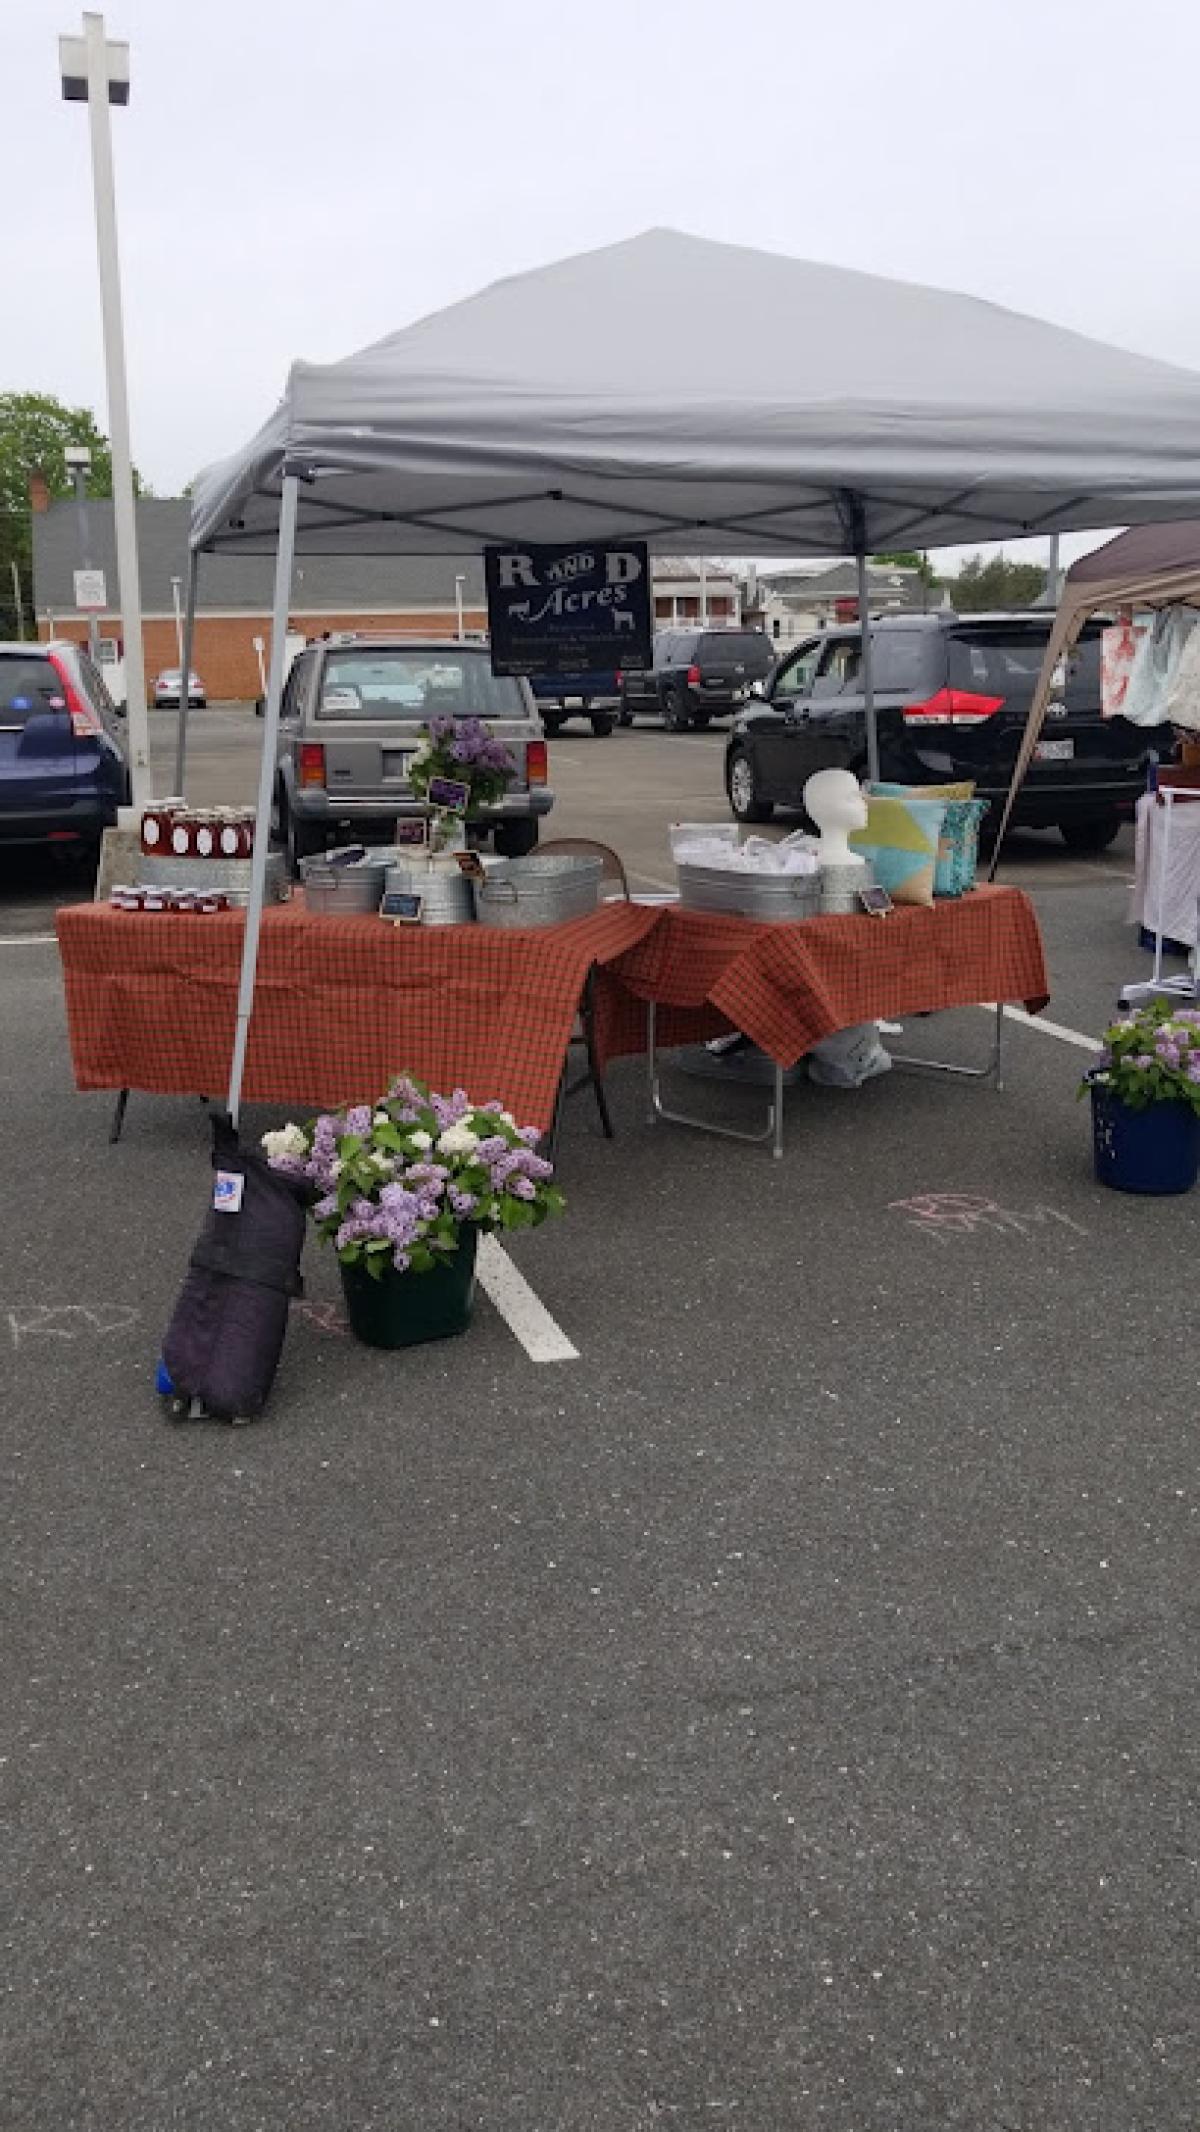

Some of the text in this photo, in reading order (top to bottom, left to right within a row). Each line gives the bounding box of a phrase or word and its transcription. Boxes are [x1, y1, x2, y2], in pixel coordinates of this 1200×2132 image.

[497, 551, 642, 587] R AND D
[532, 585, 628, 621] Acres
